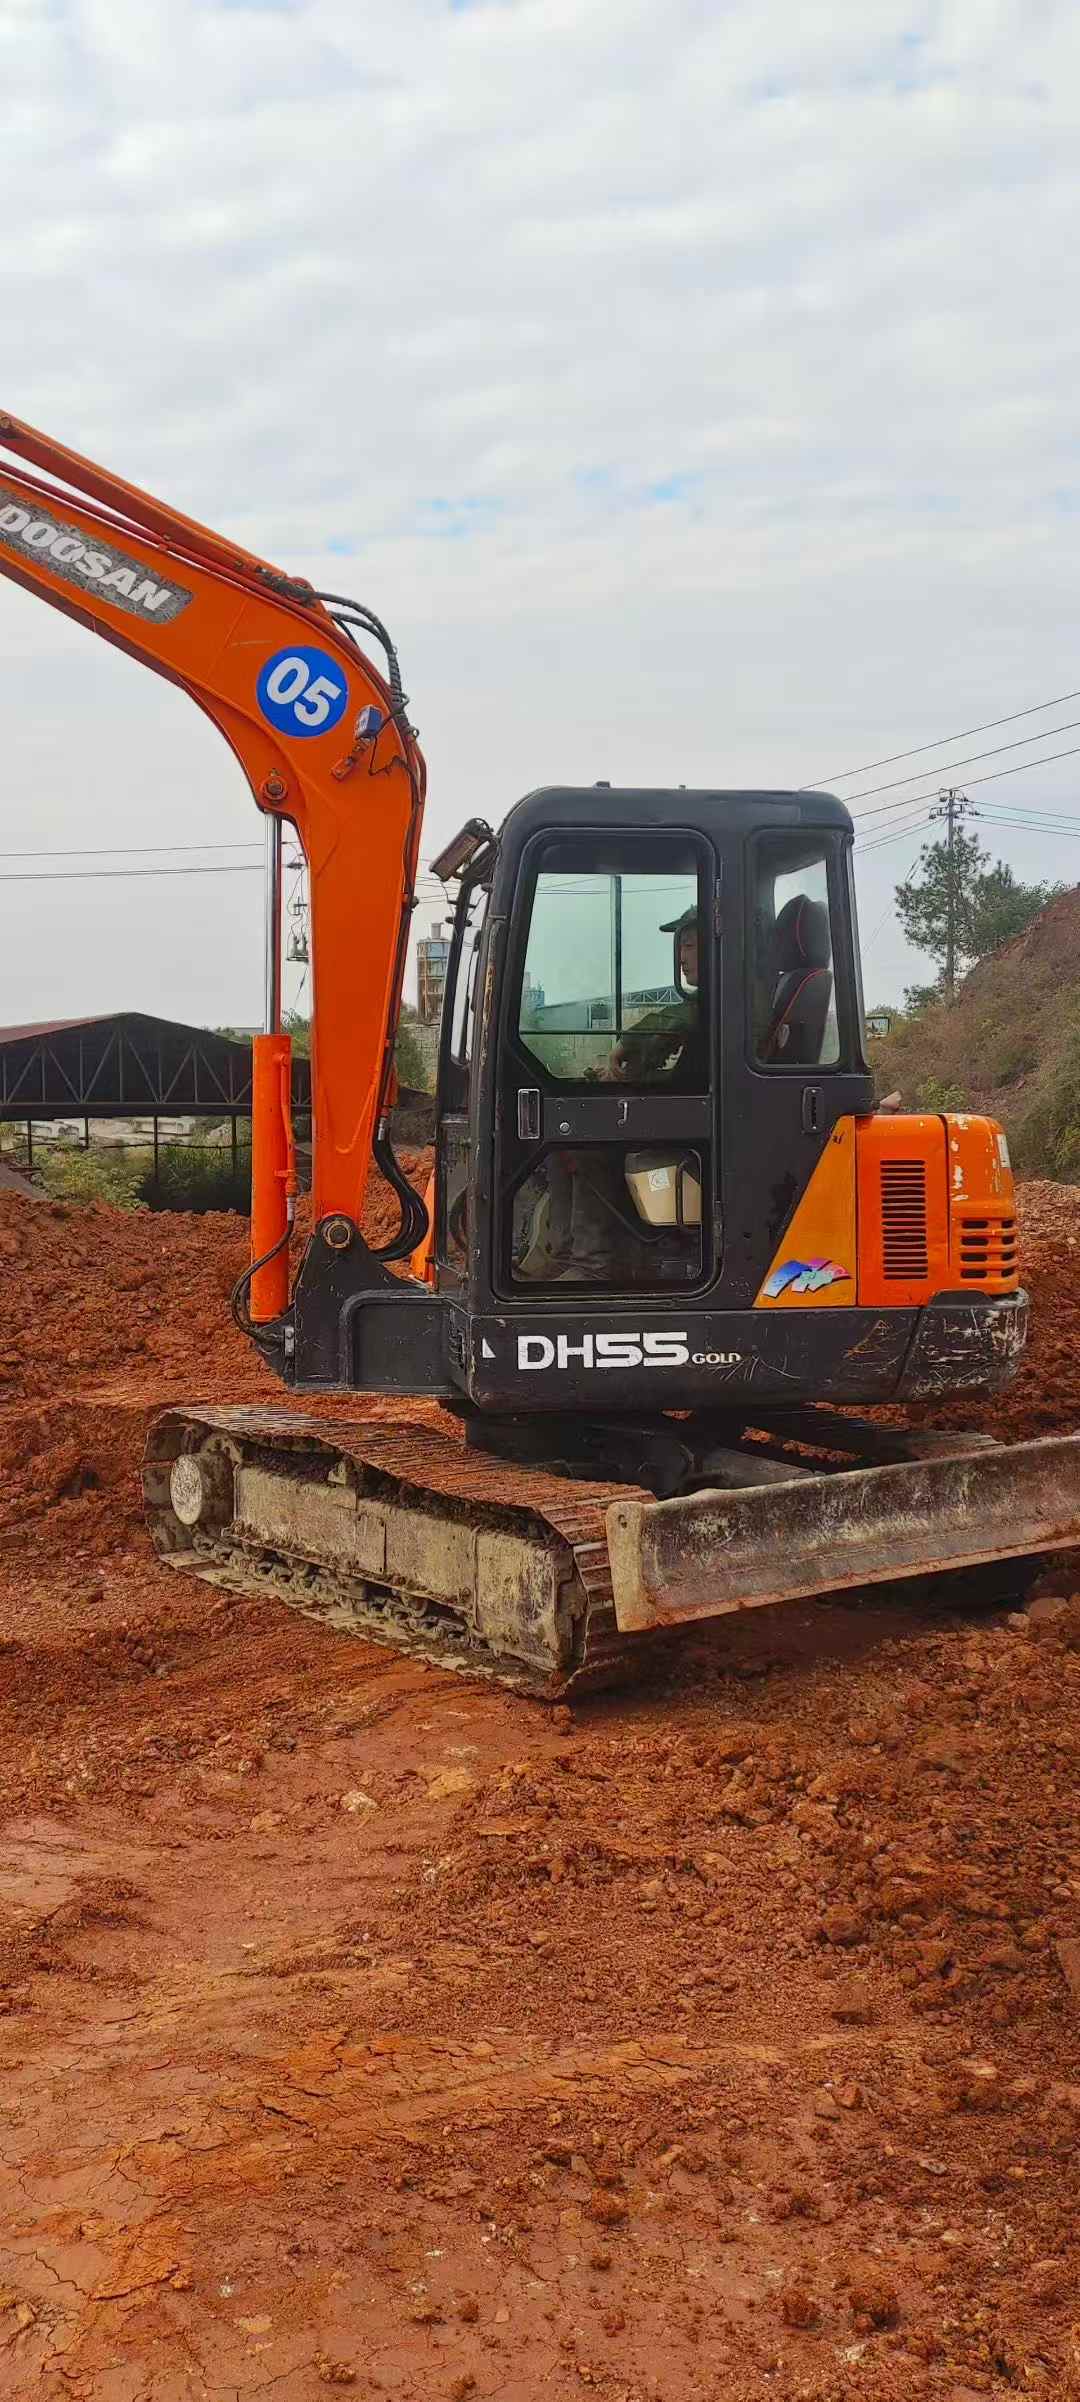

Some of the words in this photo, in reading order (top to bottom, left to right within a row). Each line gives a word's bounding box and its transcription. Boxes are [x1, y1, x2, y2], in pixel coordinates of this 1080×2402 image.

[0, 504, 173, 611] DOOSAN
[267, 657, 342, 726] 05
[518, 1332, 689, 1370] DH55
[692, 1352, 741, 1364] GOLD
